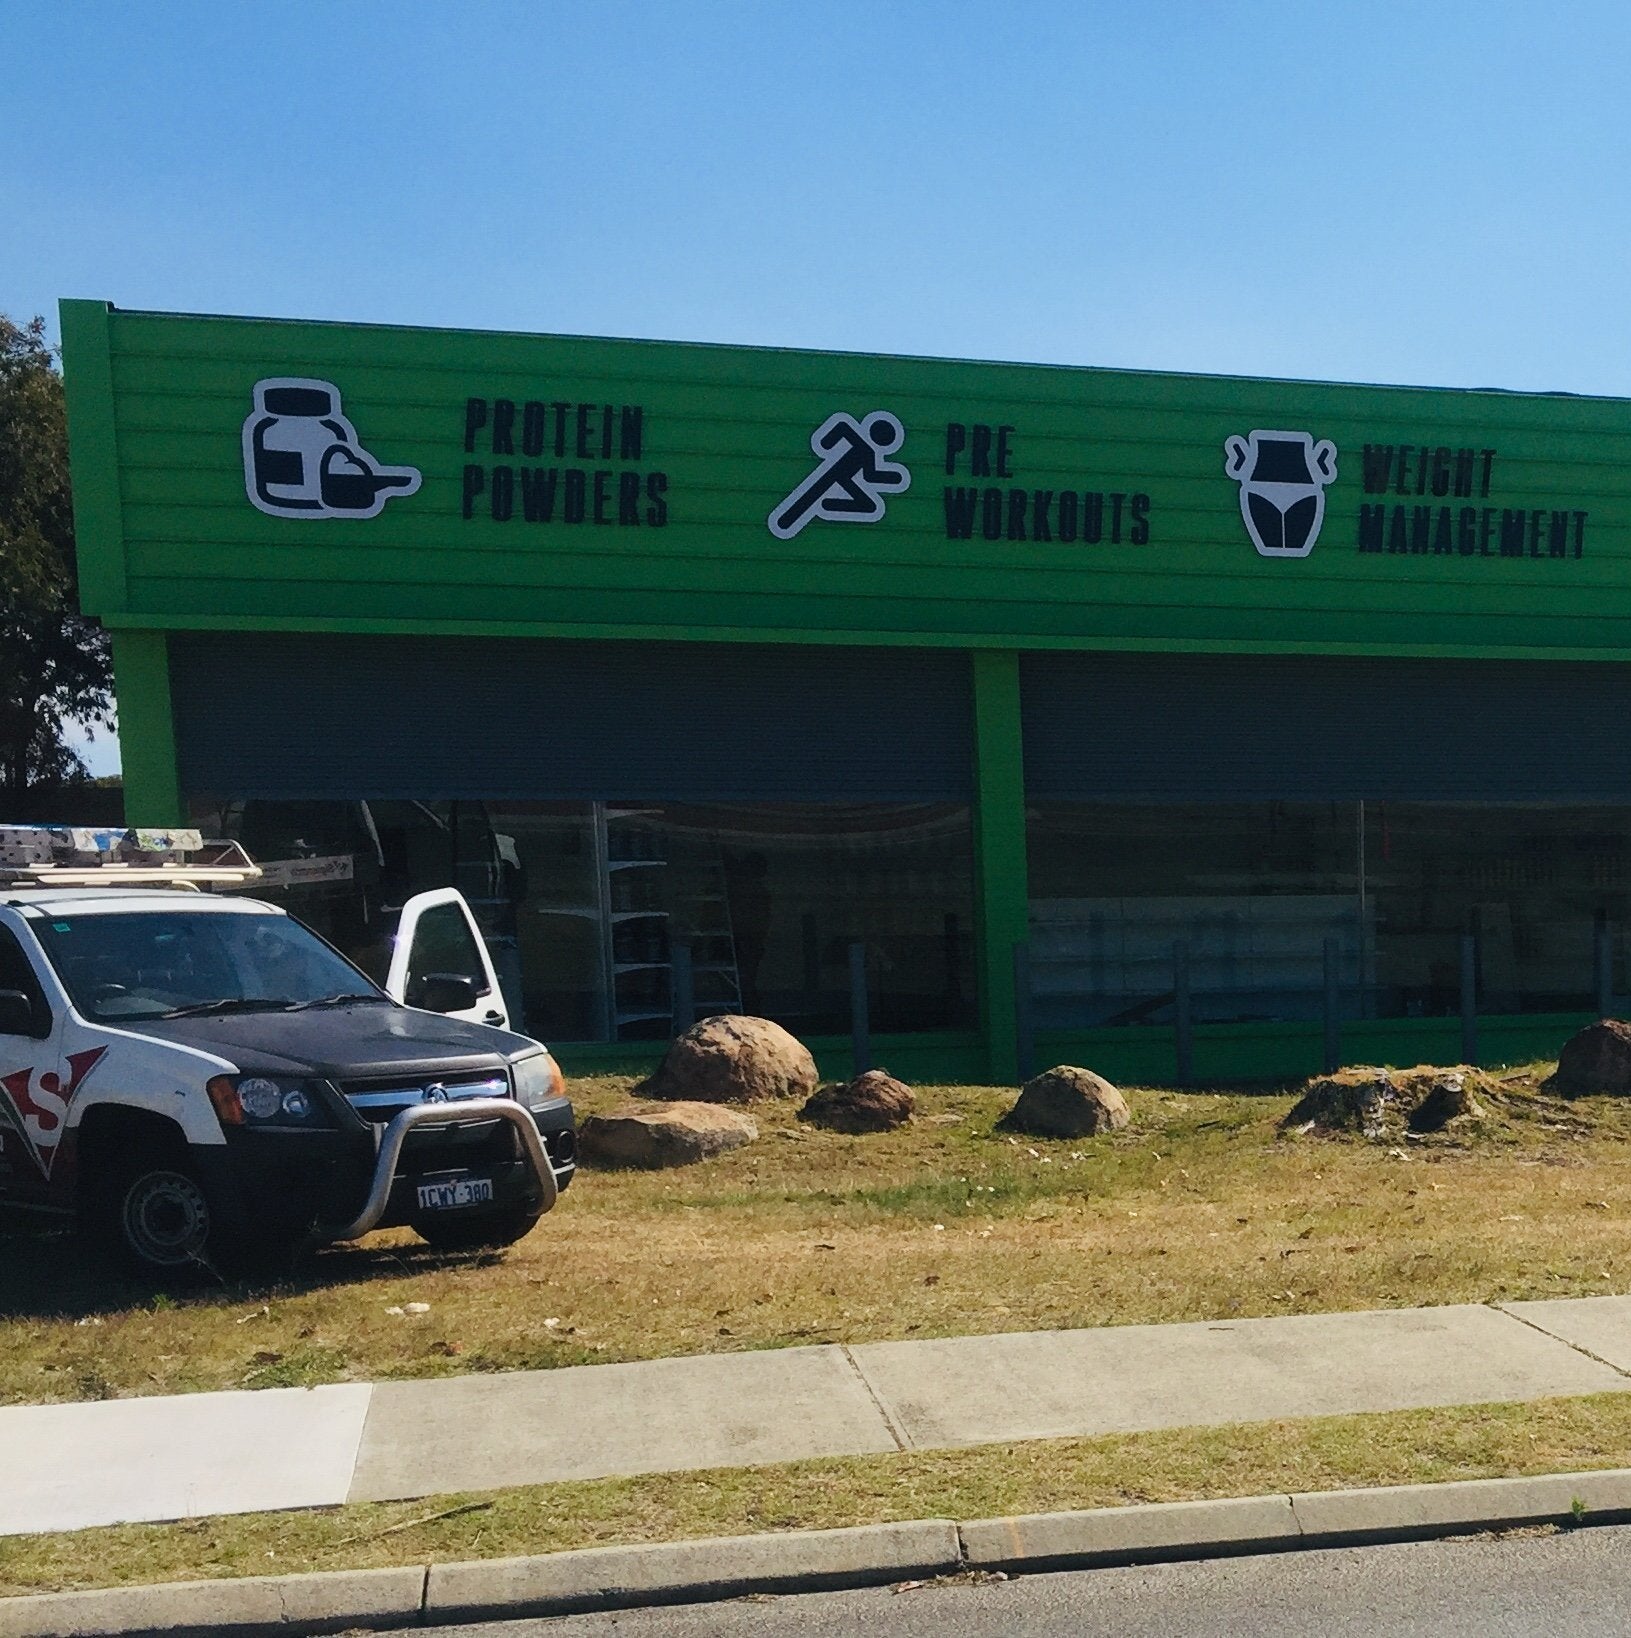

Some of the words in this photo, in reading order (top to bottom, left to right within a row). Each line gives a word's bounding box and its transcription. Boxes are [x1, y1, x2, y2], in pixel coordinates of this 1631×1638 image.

[463, 397, 643, 461] PROTEIN
[946, 422, 1015, 479] PRE
[462, 465, 669, 528] POWDERS
[1362, 444, 1497, 498] WEIGHT
[944, 486, 1150, 545] WORKOUTS
[1358, 503, 1588, 560] MANAGEMENT
